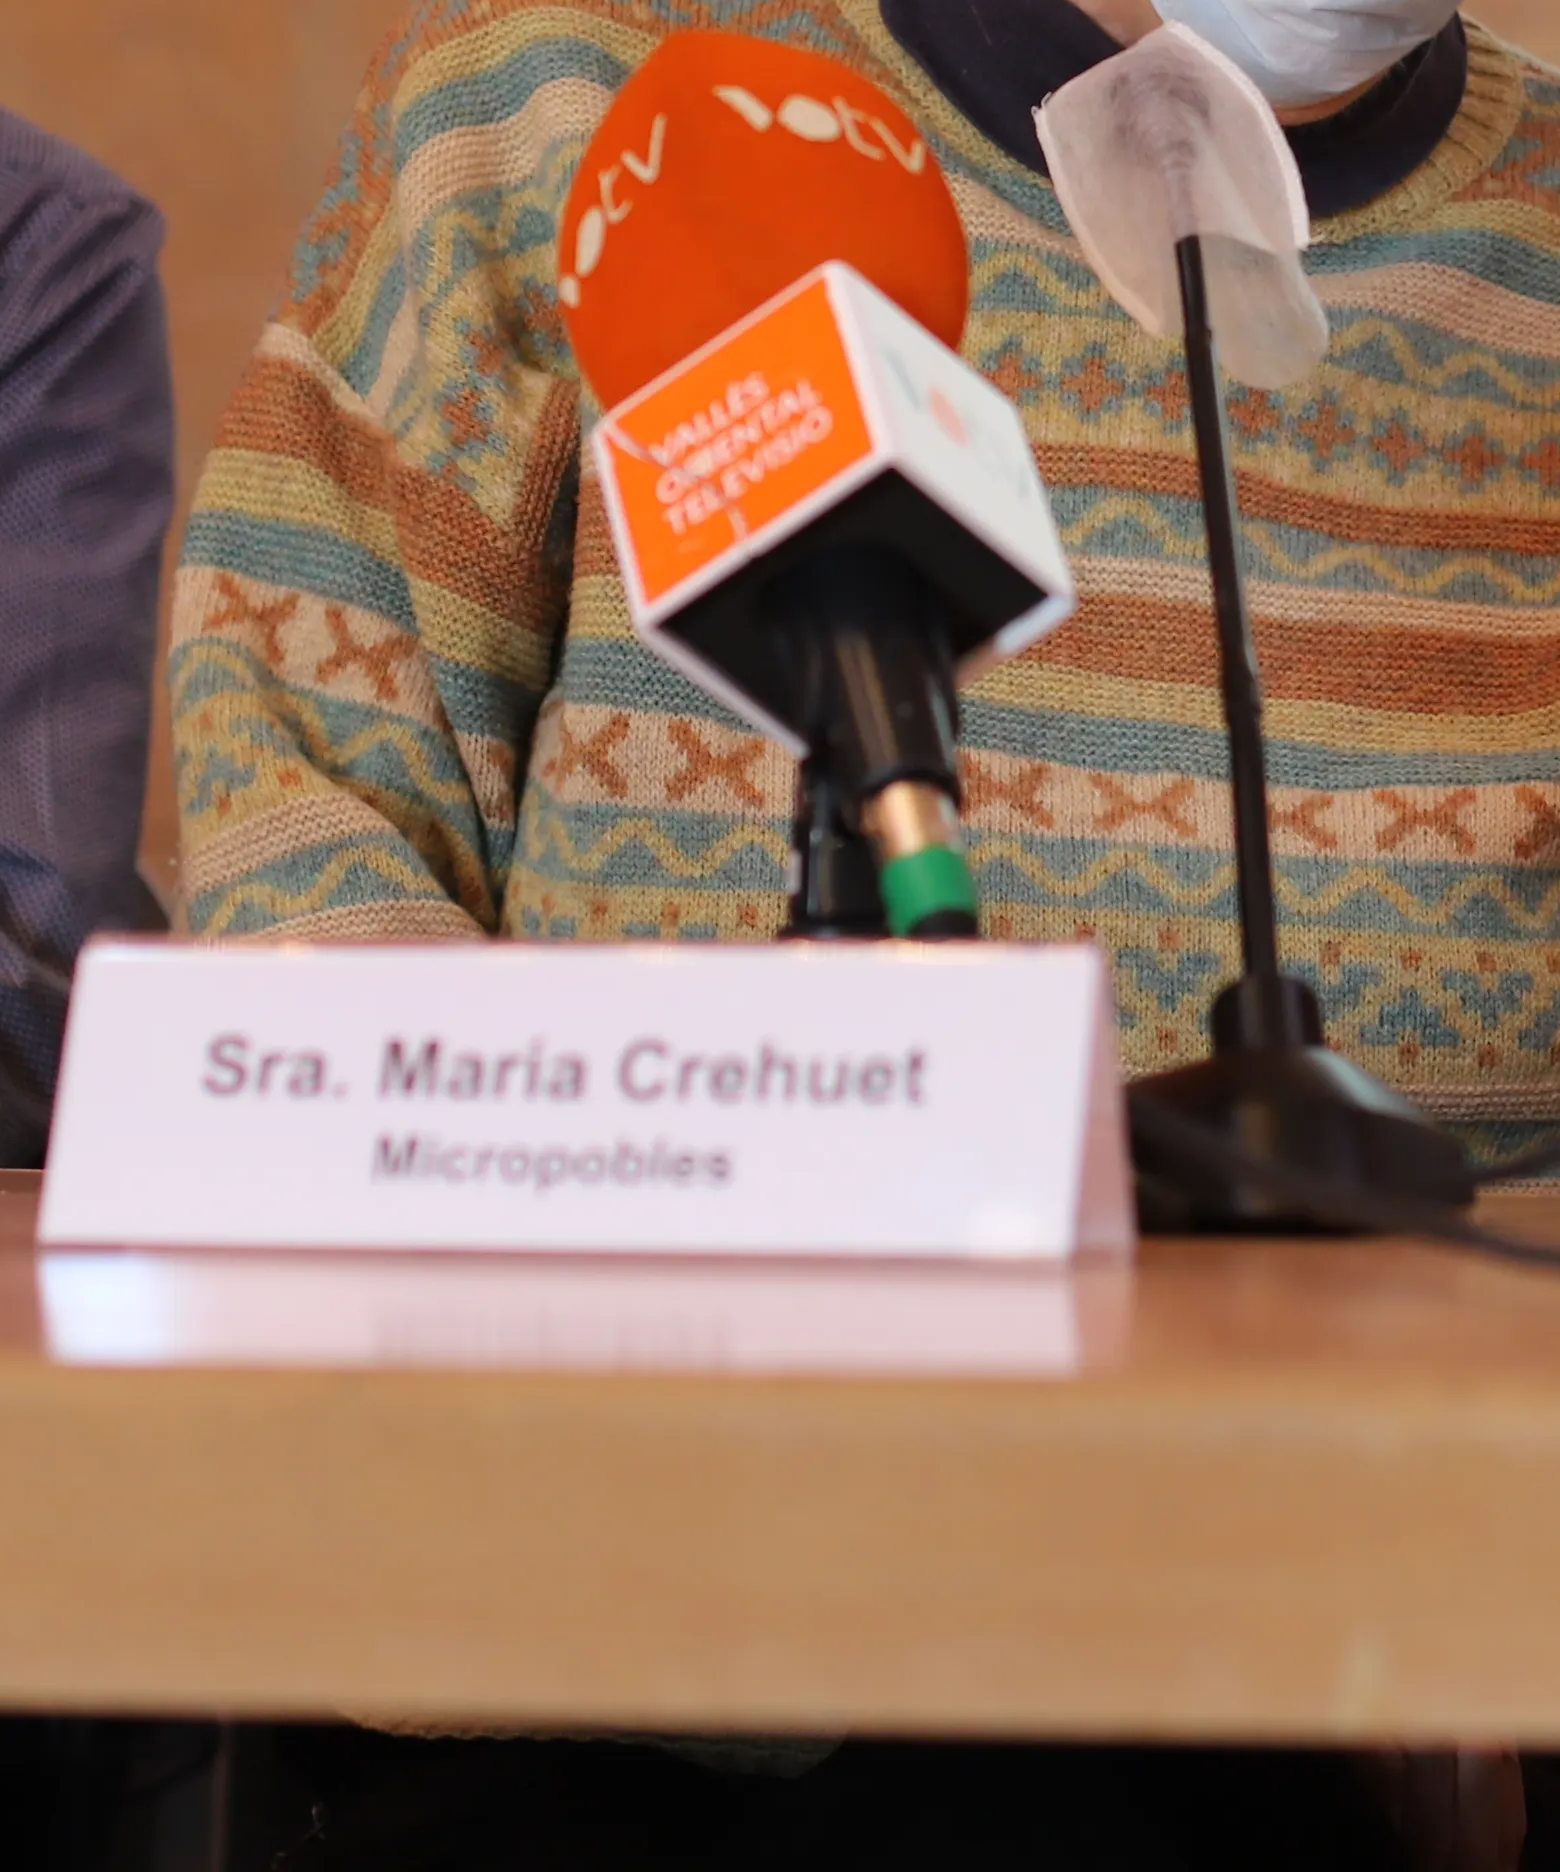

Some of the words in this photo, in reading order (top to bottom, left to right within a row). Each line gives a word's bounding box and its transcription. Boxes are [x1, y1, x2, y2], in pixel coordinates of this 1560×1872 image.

[655, 378, 823, 505] ORIENTAL
[202, 1034, 348, 1100] Sra.
[376, 1036, 588, 1102] Maria
[615, 1038, 928, 1108] Crehuet
[371, 1135, 733, 1193] Micropobles
